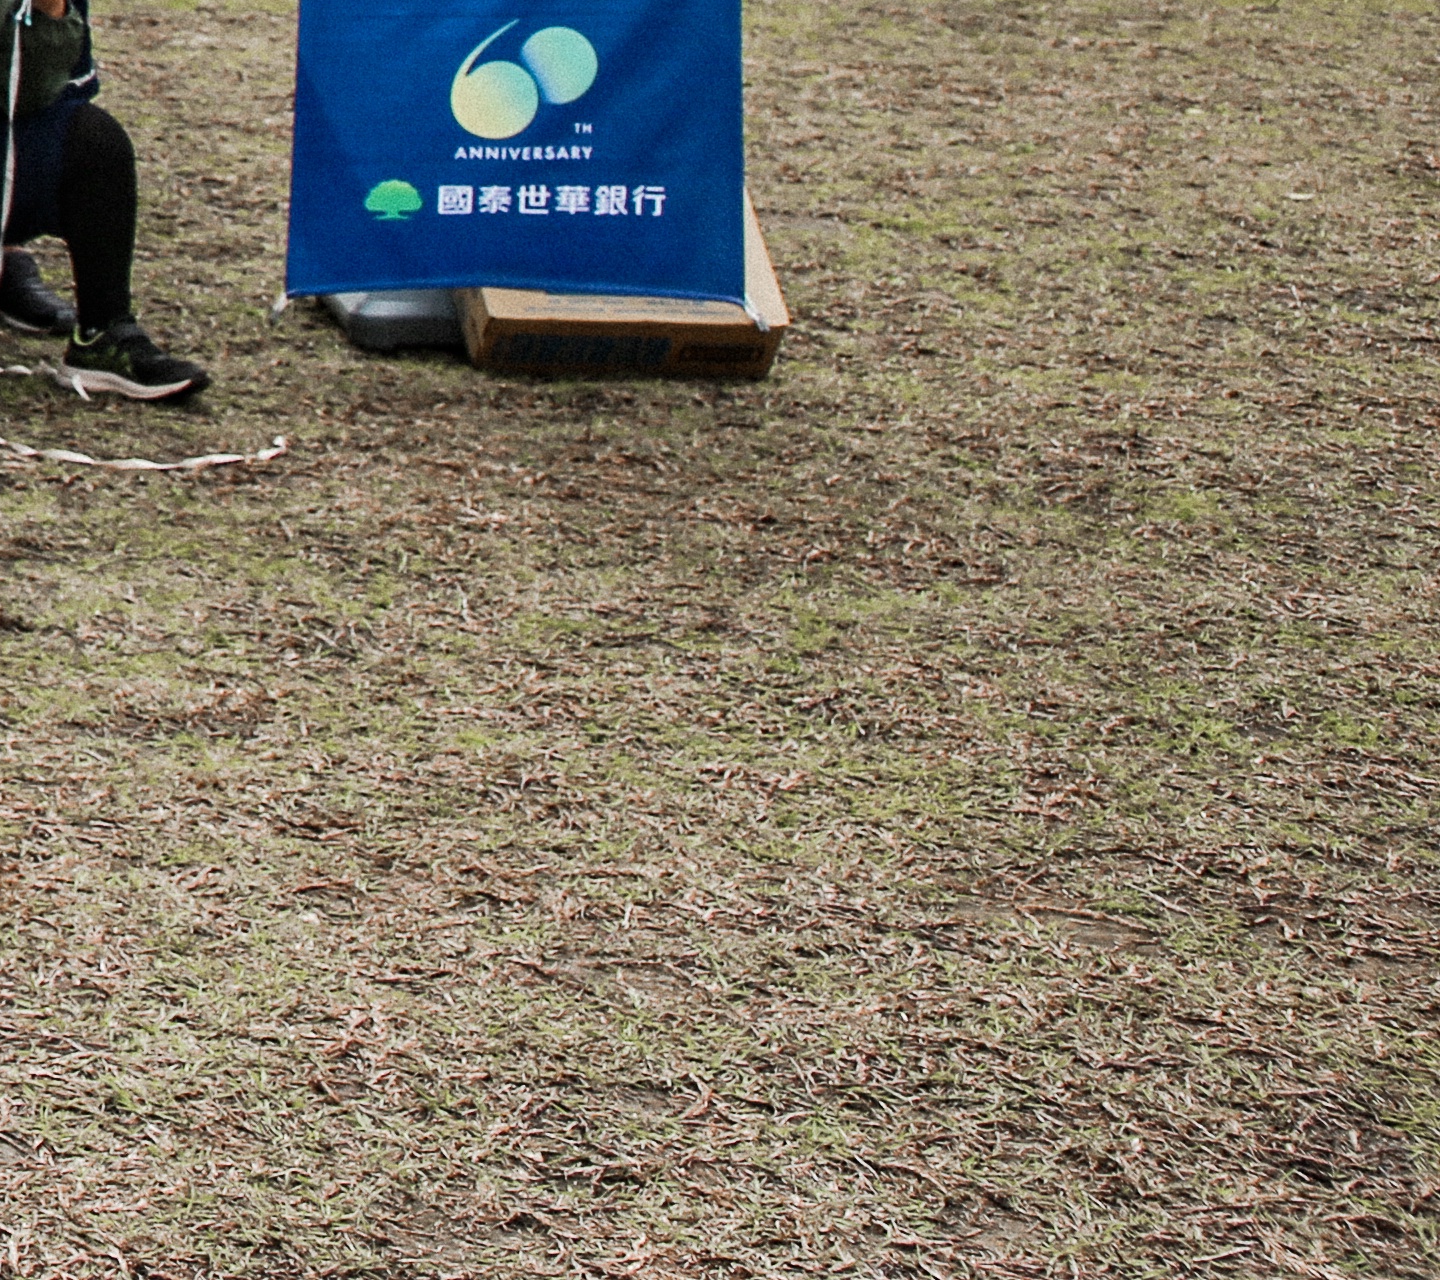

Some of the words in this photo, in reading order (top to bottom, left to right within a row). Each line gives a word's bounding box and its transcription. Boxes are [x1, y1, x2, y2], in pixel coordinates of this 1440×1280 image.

[454, 144, 595, 162] ANNIVERSARY
[437, 184, 667, 217] 國泰世華銀行
